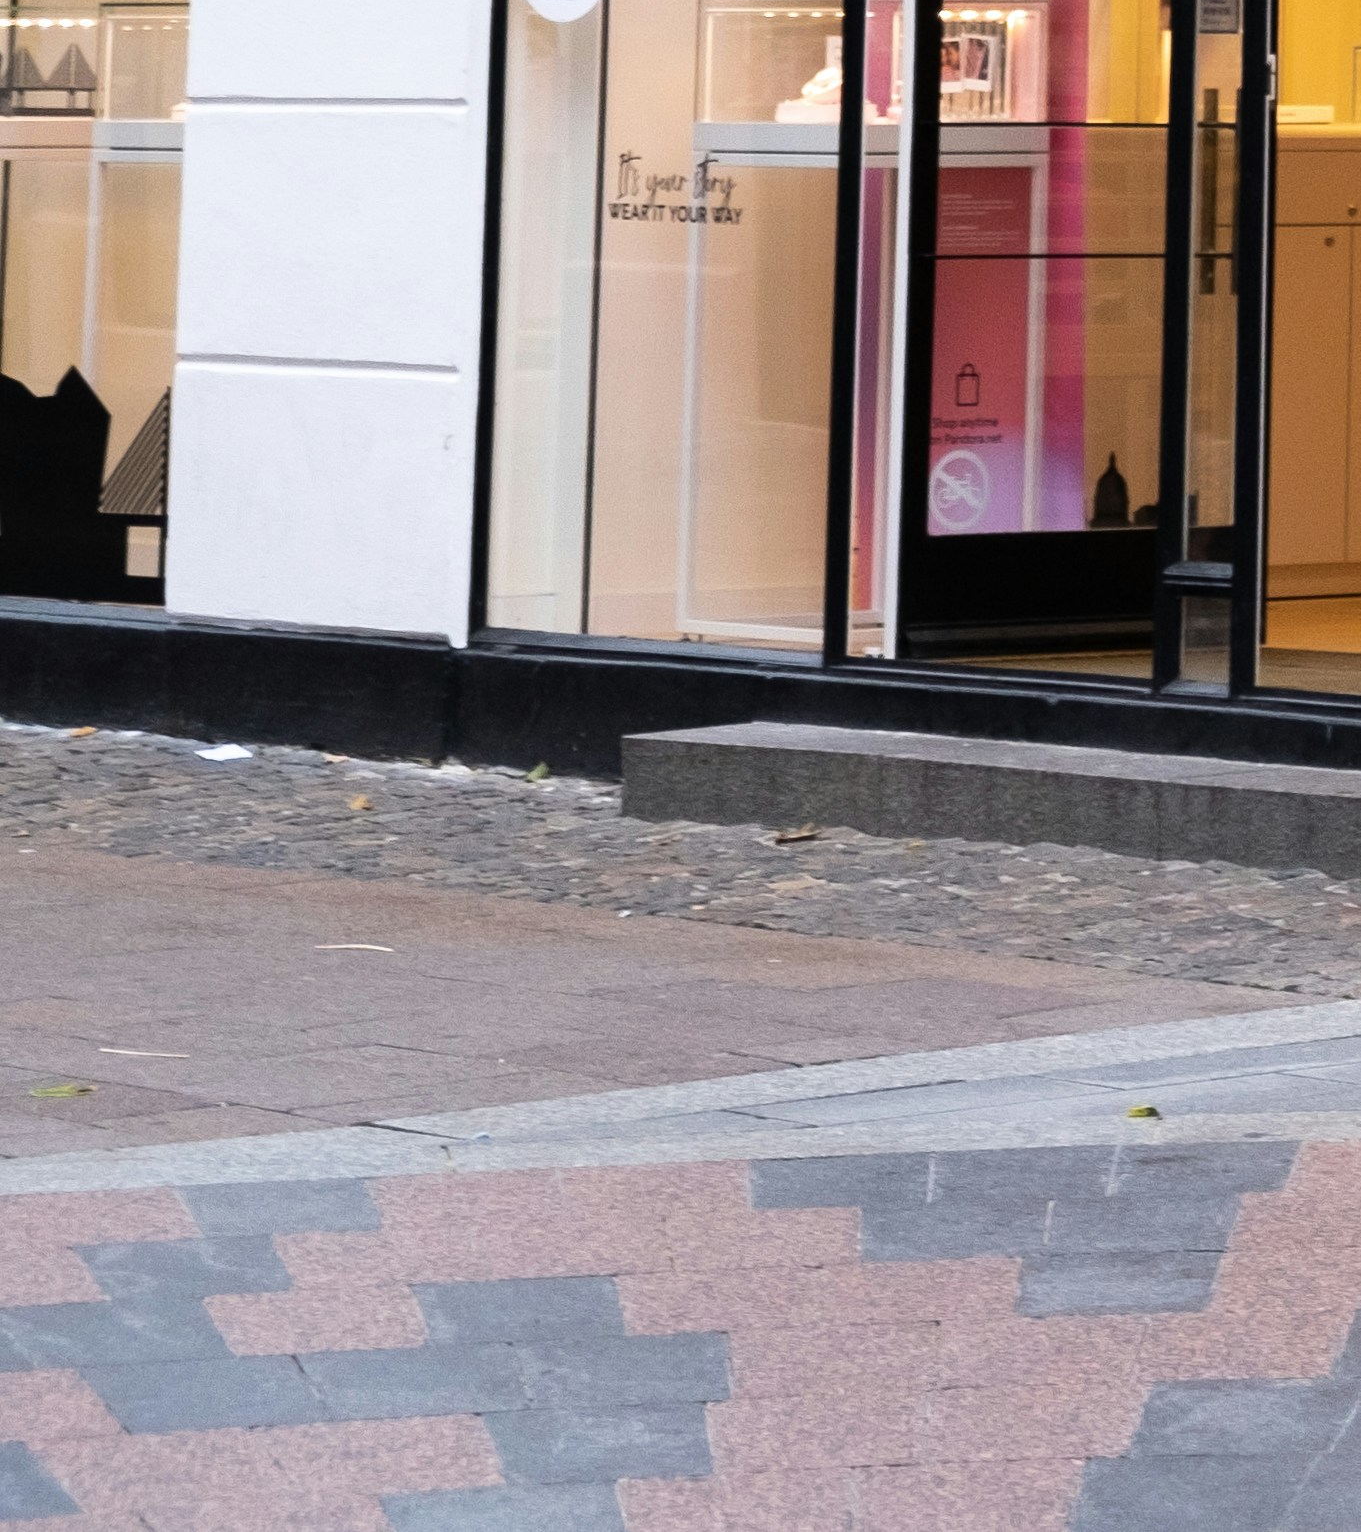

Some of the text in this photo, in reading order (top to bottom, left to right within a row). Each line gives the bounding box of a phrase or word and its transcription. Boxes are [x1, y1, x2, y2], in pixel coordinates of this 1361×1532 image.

[608, 203, 742, 224] WEAR IT YOUR WAY
